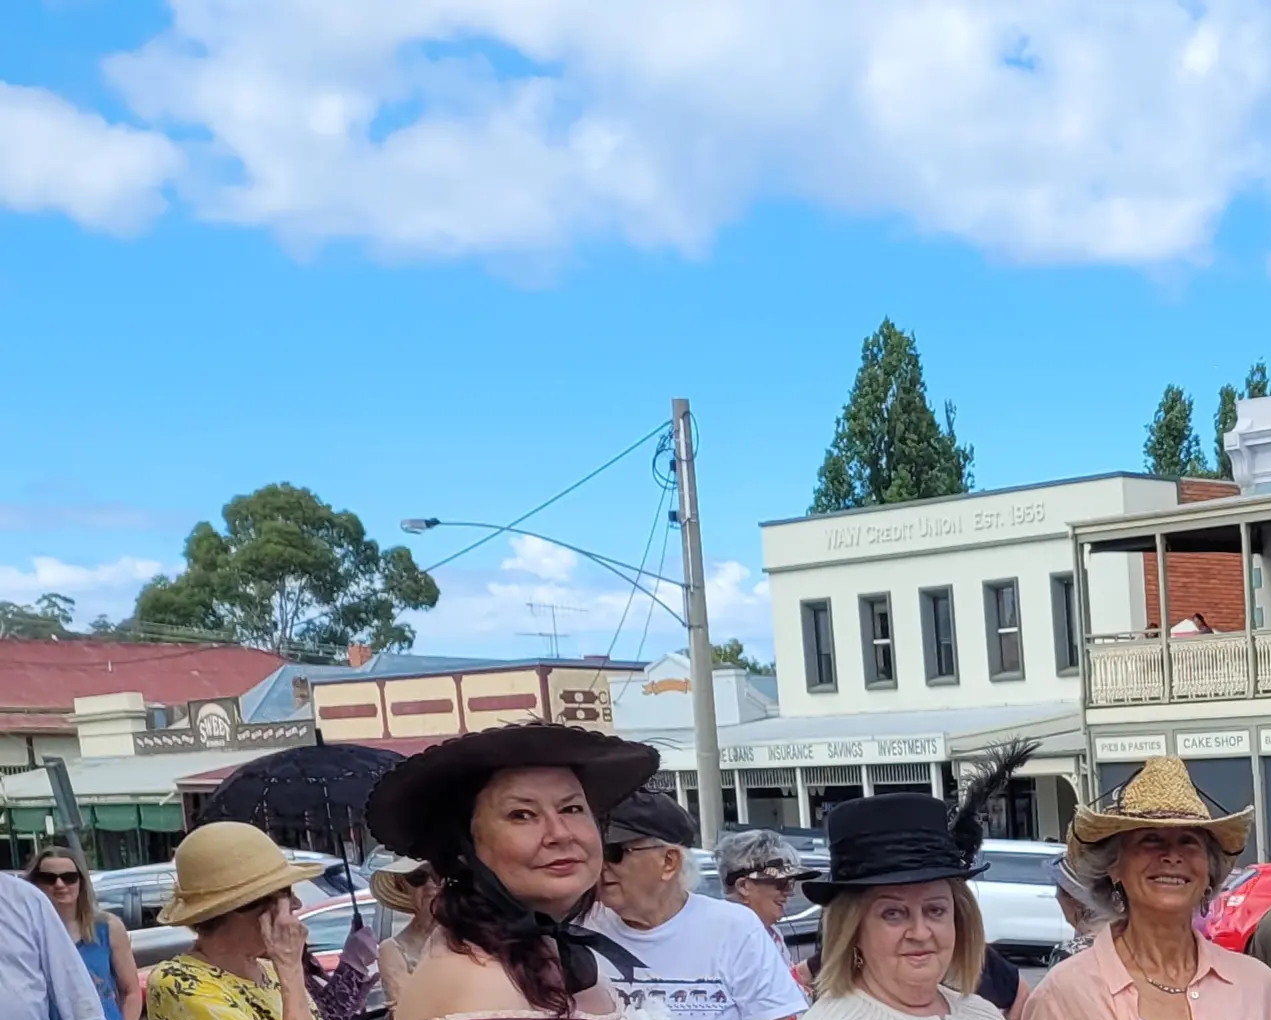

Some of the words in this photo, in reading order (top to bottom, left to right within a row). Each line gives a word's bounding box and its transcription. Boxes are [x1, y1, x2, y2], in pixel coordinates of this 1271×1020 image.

[825, 524, 862, 551] WAW
[866, 522, 914, 545] CREDIT
[916, 514, 964, 539] UNION
[199, 716, 230, 743] SWEET
[728, 745, 755, 762] LOANS
[768, 744, 814, 761] INSURANCE
[827, 742, 864, 759] SAVINGS
[877, 738, 938, 757] INVESTMENTS
[1128, 740, 1162, 751] PASTIES
[1183, 737, 1213, 749] CAKE
[1214, 735, 1244, 748] SHOP
